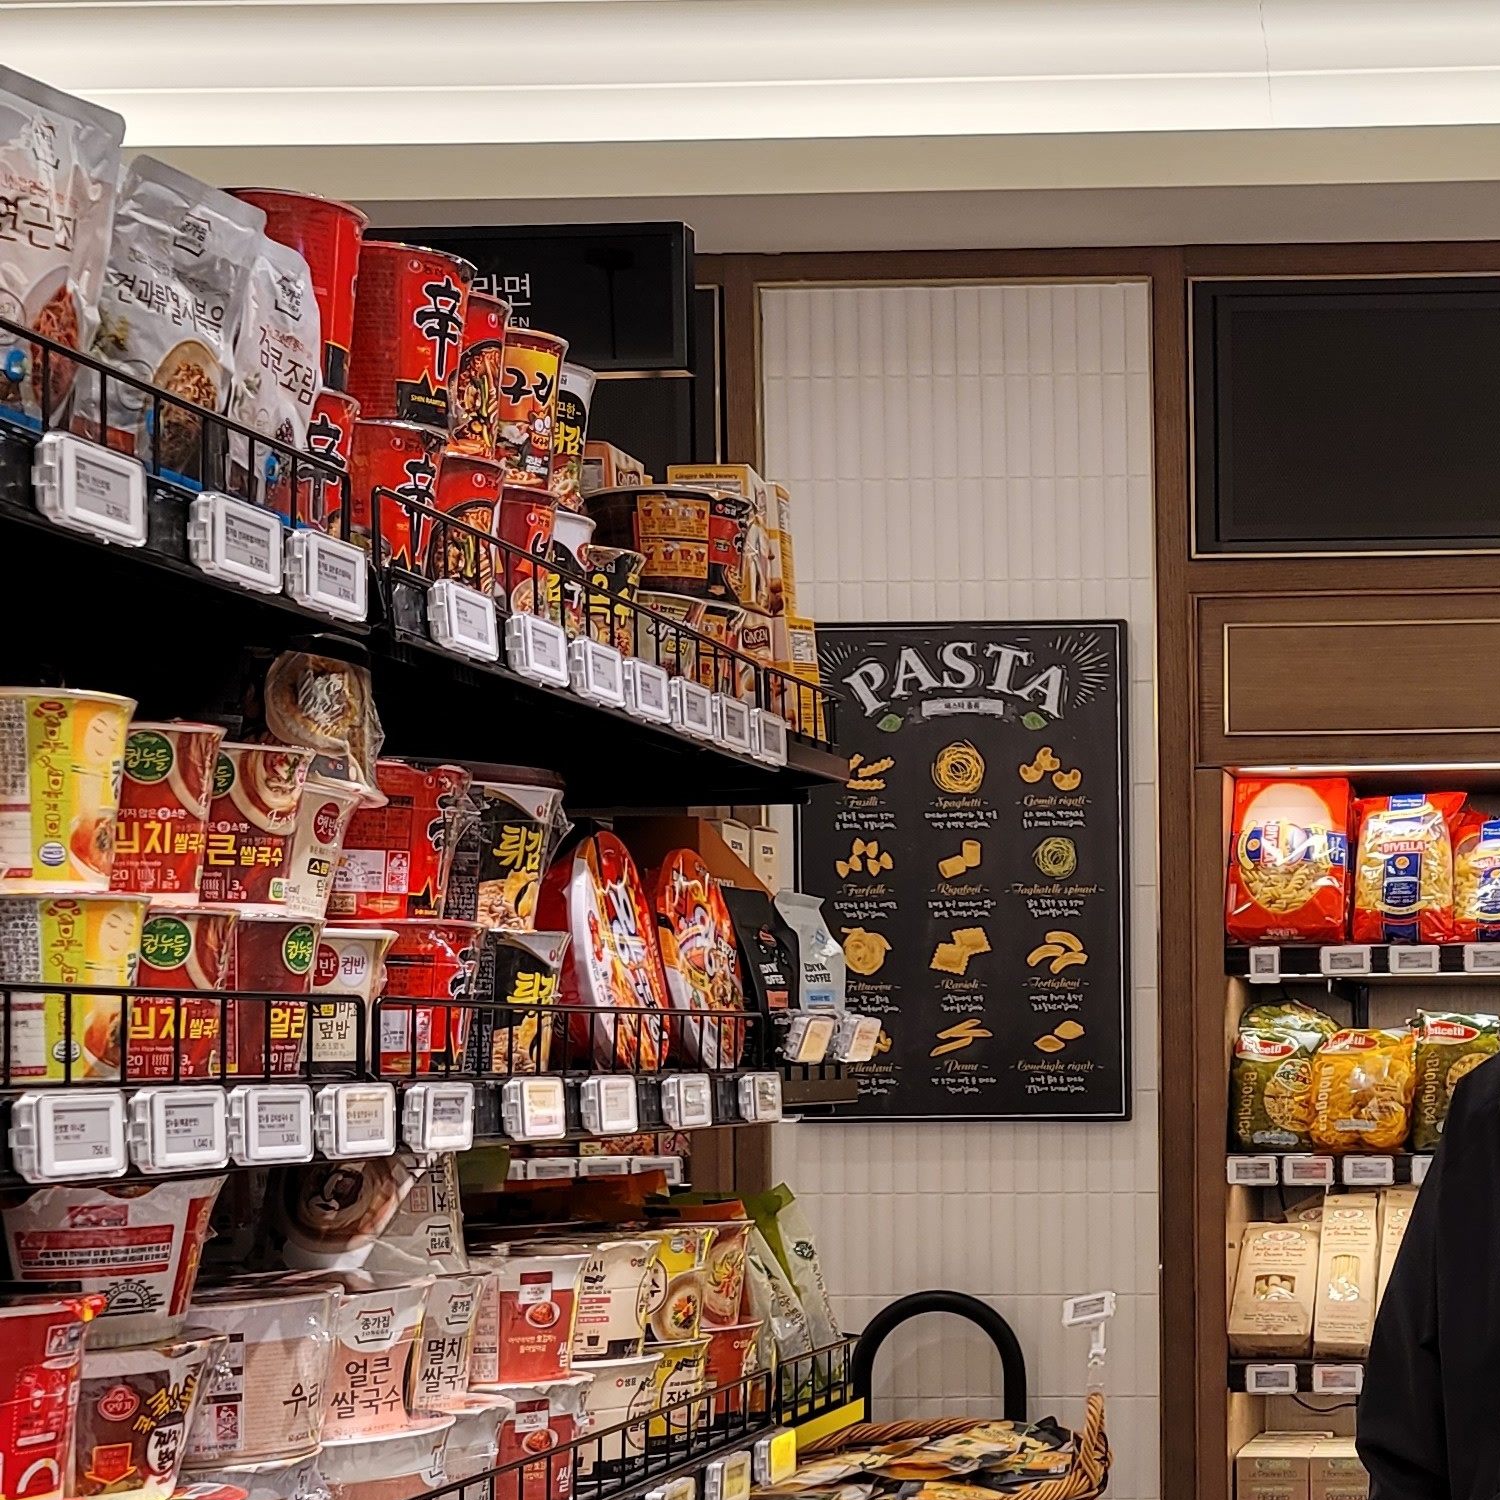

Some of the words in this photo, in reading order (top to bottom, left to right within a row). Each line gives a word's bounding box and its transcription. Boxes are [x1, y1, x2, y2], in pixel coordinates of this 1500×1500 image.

[414, 277, 463, 381] 辛
[500, 367, 551, 405] 구리
[842, 642, 1065, 719] PASTA
[125, 743, 174, 774] 컵누들
[240, 846, 283, 866] 쌀국수
[493, 824, 543, 870] 튀김
[1383, 841, 1426, 853] DIVELLA
[141, 932, 192, 954] 컵누들
[341, 956, 366, 975] 컵반
[804, 973, 833, 984] COFFEE
[942, 979, 979, 991] Ravioli
[319, 1020, 350, 1041] 덮밥
[849, 1062, 894, 1074] ellentani
[946, 1061, 979, 1074] Penne
[361, 1315, 390, 1331] 종가집
[345, 1357, 392, 1388] 얼큰
[331, 1387, 401, 1417] 쌀국수
